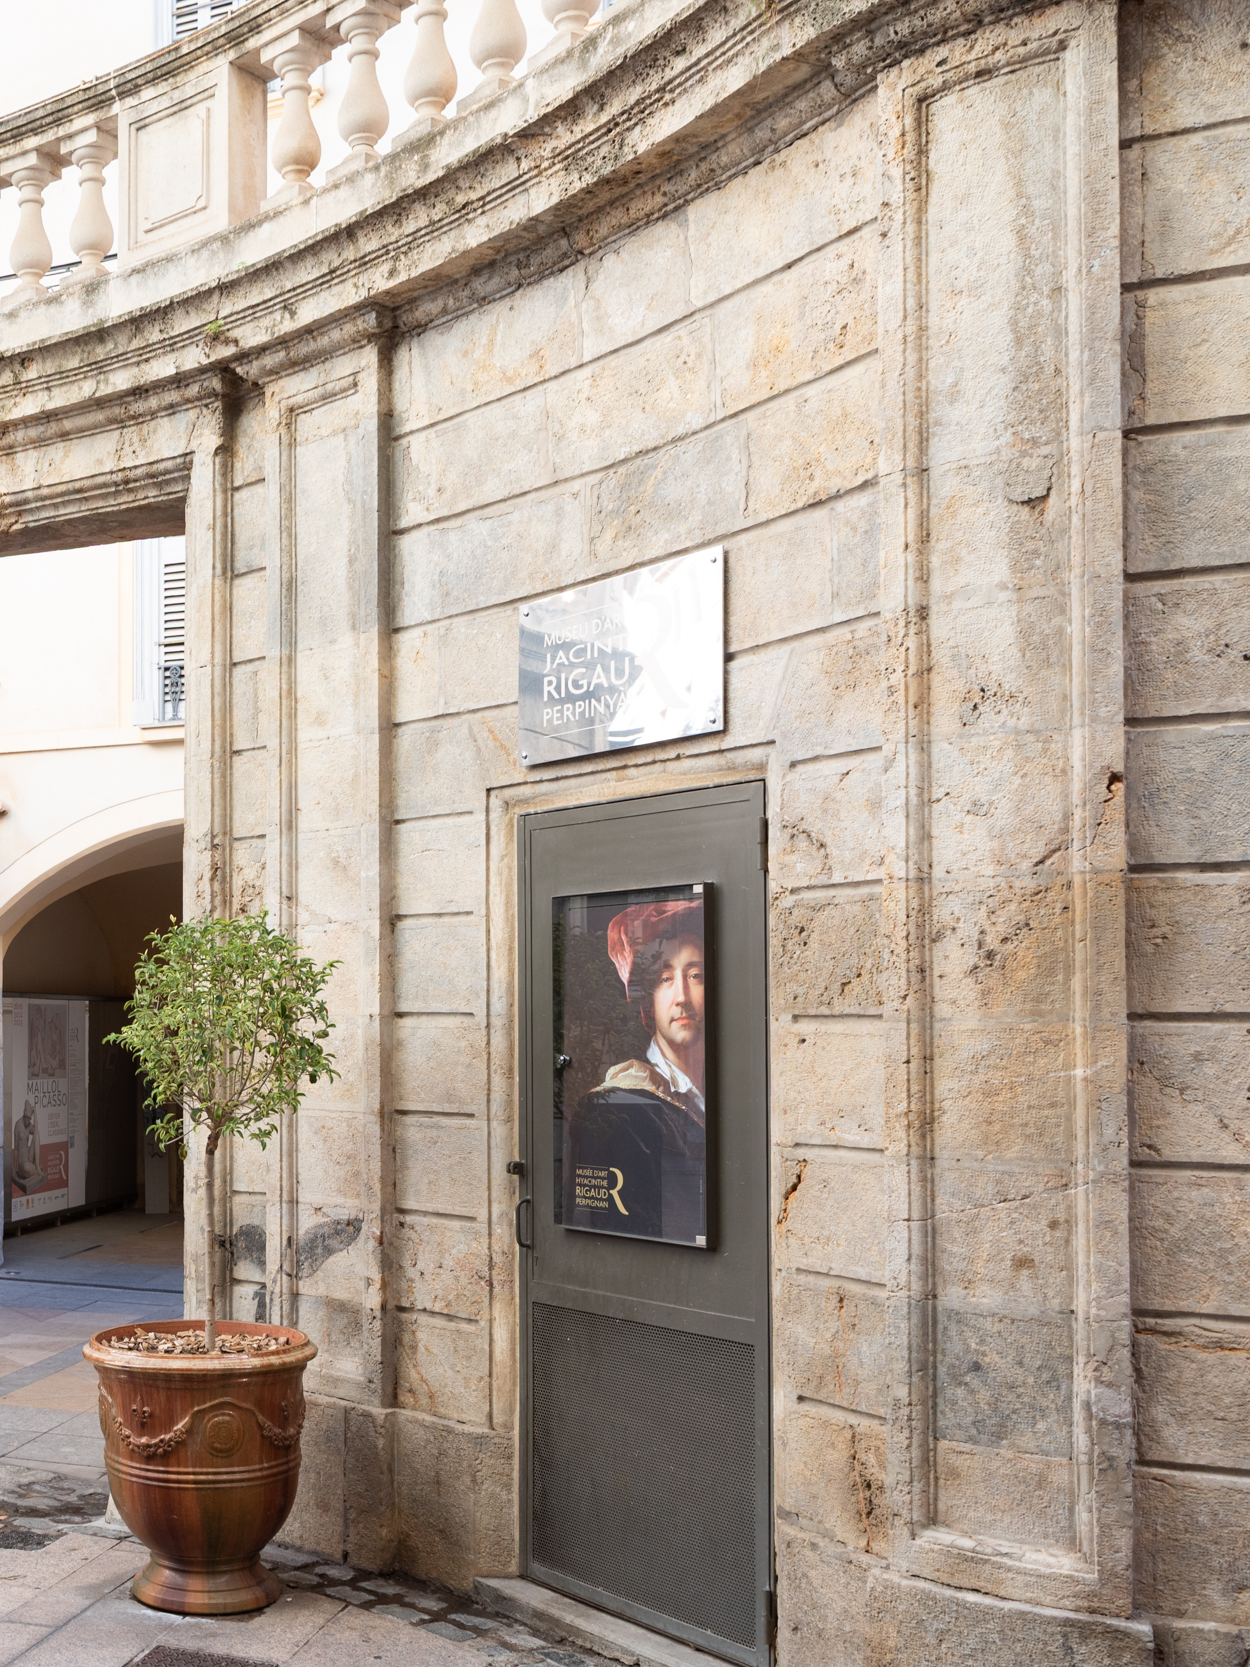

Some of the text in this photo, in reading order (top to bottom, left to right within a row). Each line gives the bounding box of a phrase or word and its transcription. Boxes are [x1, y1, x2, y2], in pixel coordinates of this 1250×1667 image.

[543, 614, 622, 648] MUSEU D'AR
[543, 632, 629, 673] JACINT
[543, 656, 630, 701] RIGAU
[543, 687, 627, 727] PERPINYÀ
[26, 1080, 62, 1095] MAILLOL
[34, 1093, 68, 1109] PICASSO
[575, 1167, 609, 1177] MUSÉE D'ART
[575, 1177, 609, 1188] HYACINTHE
[575, 1186, 609, 1199] RIGAUD
[609, 1167, 629, 1216] R
[575, 1197, 609, 1208] PERPIGNAN
